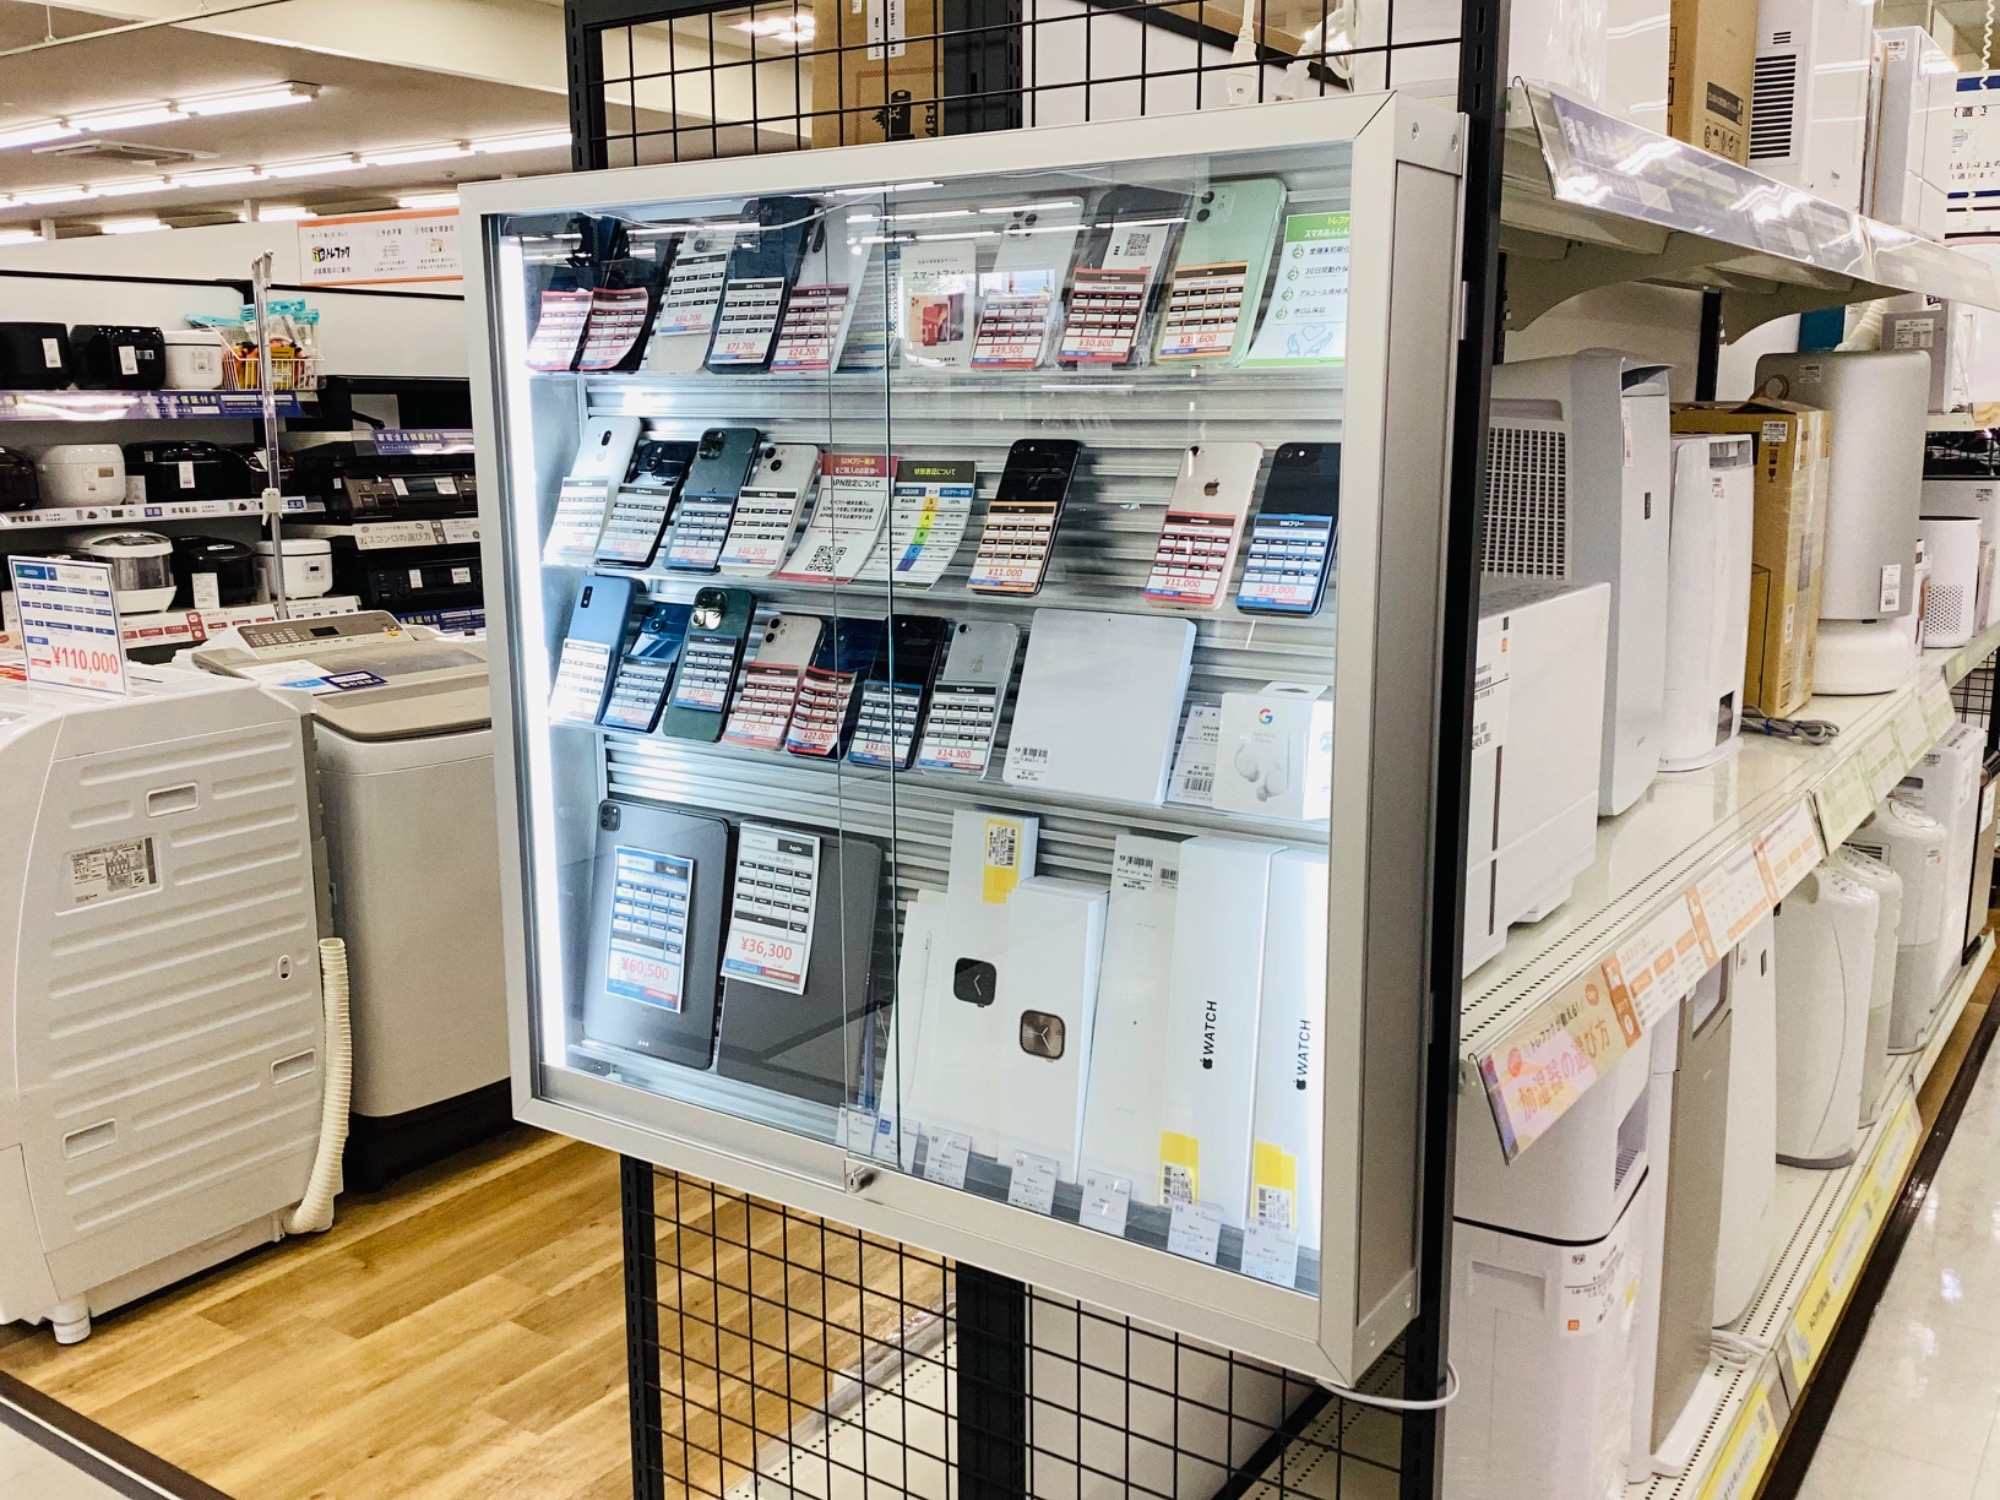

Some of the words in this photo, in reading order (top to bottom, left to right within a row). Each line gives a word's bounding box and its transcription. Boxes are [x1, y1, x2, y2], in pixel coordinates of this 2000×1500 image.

[988, 567, 1023, 577] ¥11,000
[51, 644, 119, 675] ¥110,000
[788, 844, 803, 853] Apple
[740, 936, 793, 961] ¥36,300
[621, 957, 670, 981] ¥60,500
[1202, 1000, 1218, 1055] WATCH
[1297, 1019, 1311, 1076] WATCH
